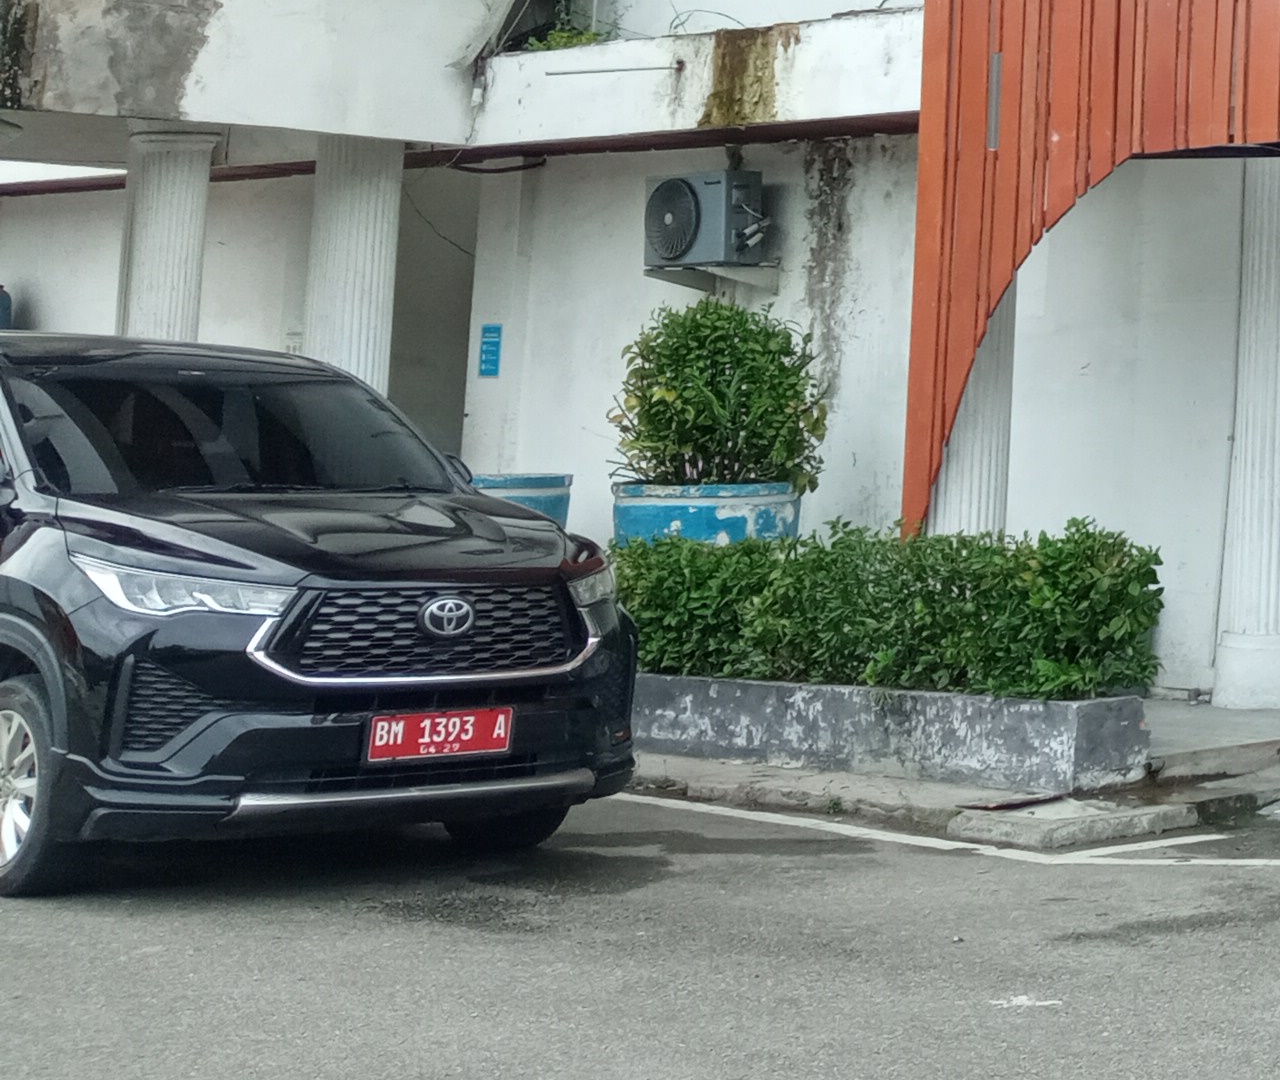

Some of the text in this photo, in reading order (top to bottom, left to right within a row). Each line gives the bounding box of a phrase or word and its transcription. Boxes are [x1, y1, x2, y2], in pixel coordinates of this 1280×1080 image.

[374, 713, 506, 747] BM 1393 A
